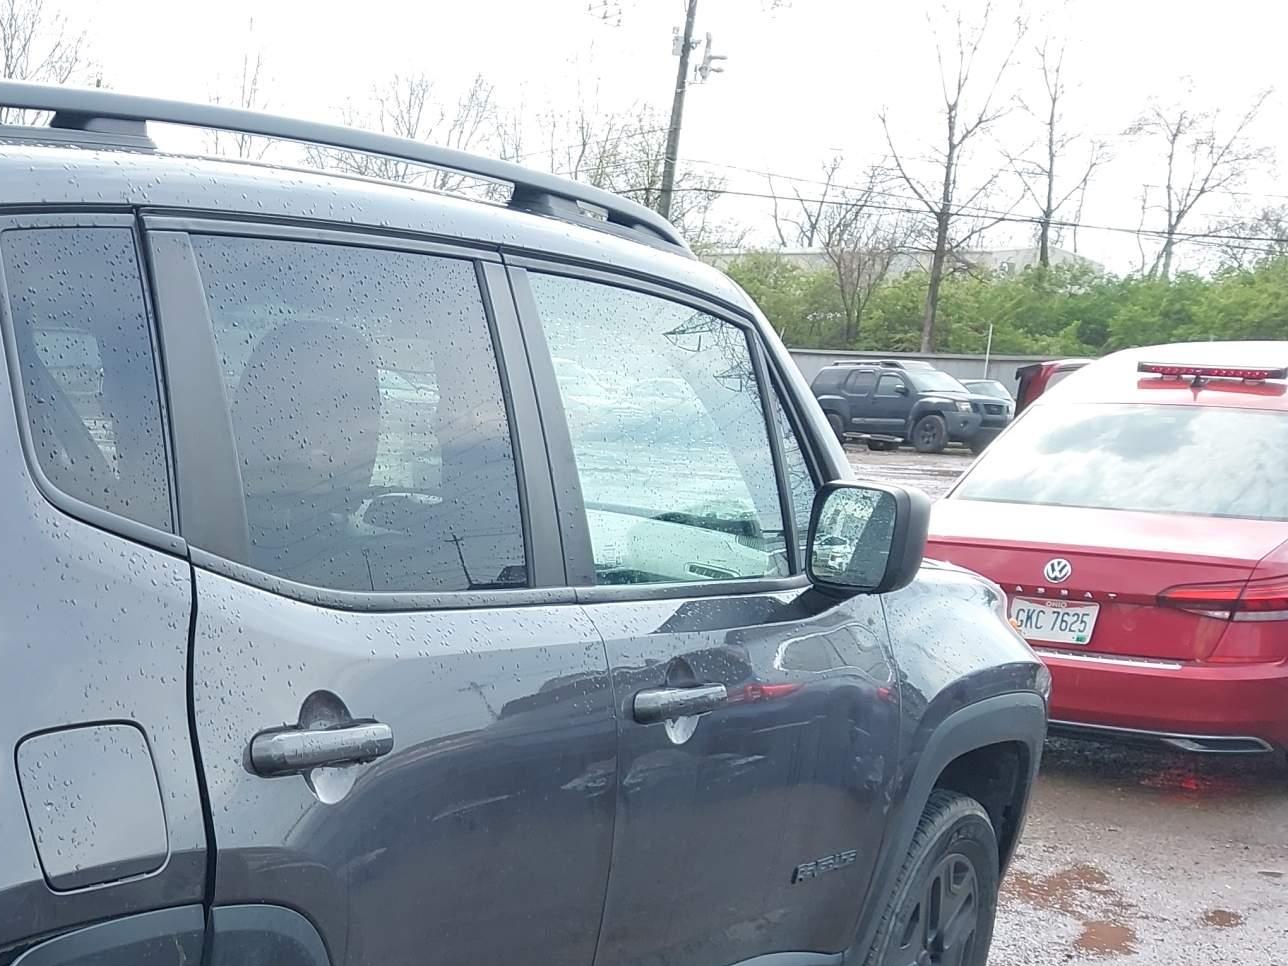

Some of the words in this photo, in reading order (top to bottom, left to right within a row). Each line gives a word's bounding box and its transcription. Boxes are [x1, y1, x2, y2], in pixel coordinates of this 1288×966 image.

[1015, 585, 1117, 600] ASSAT
[1046, 601, 1068, 609] OHIO
[1016, 608, 1046, 630] GKC
[1050, 610, 1091, 634] 7625
